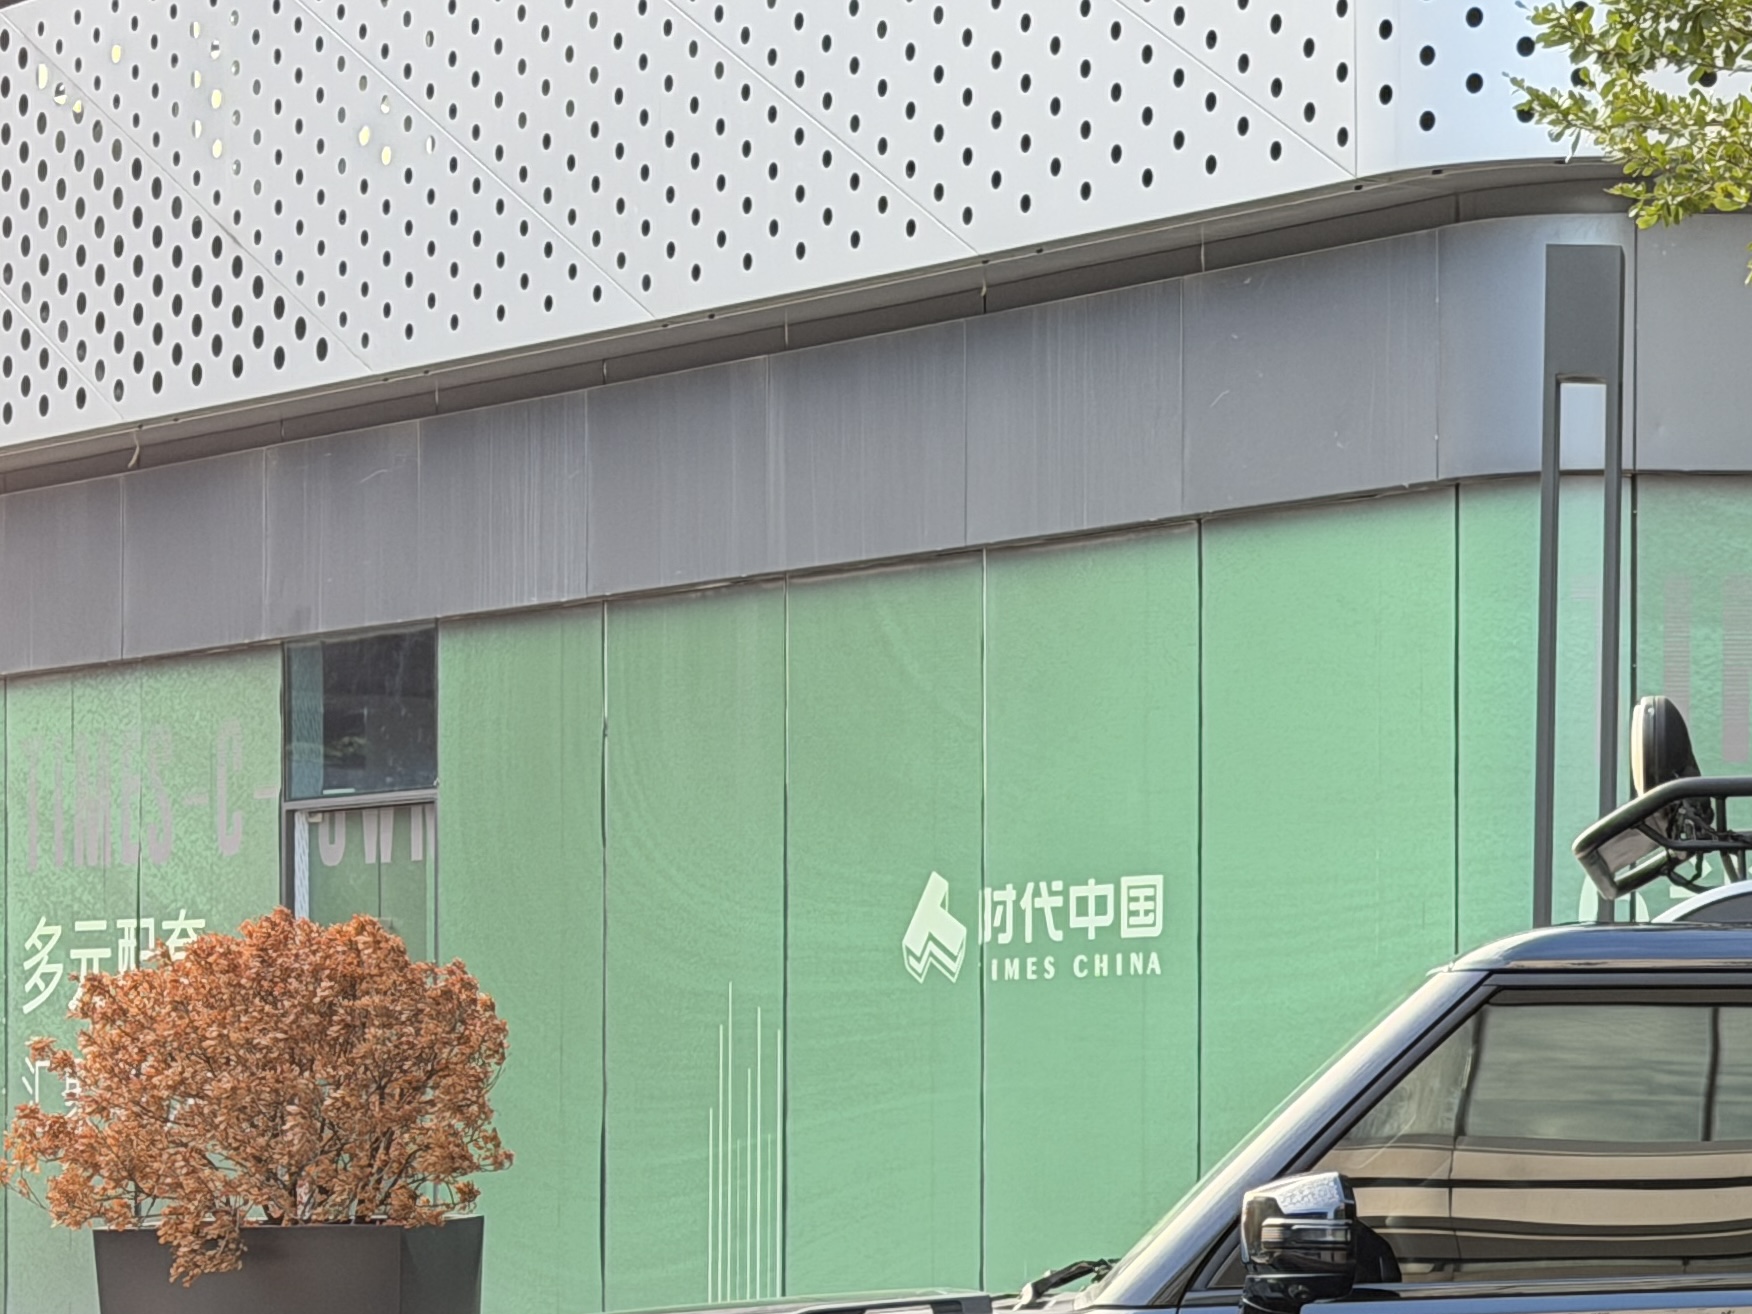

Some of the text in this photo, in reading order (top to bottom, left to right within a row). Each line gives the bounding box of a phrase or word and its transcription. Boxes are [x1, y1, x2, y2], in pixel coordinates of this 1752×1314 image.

[979, 875, 1163, 943] 时代中国
[990, 951, 1161, 981] IMES CHINA
